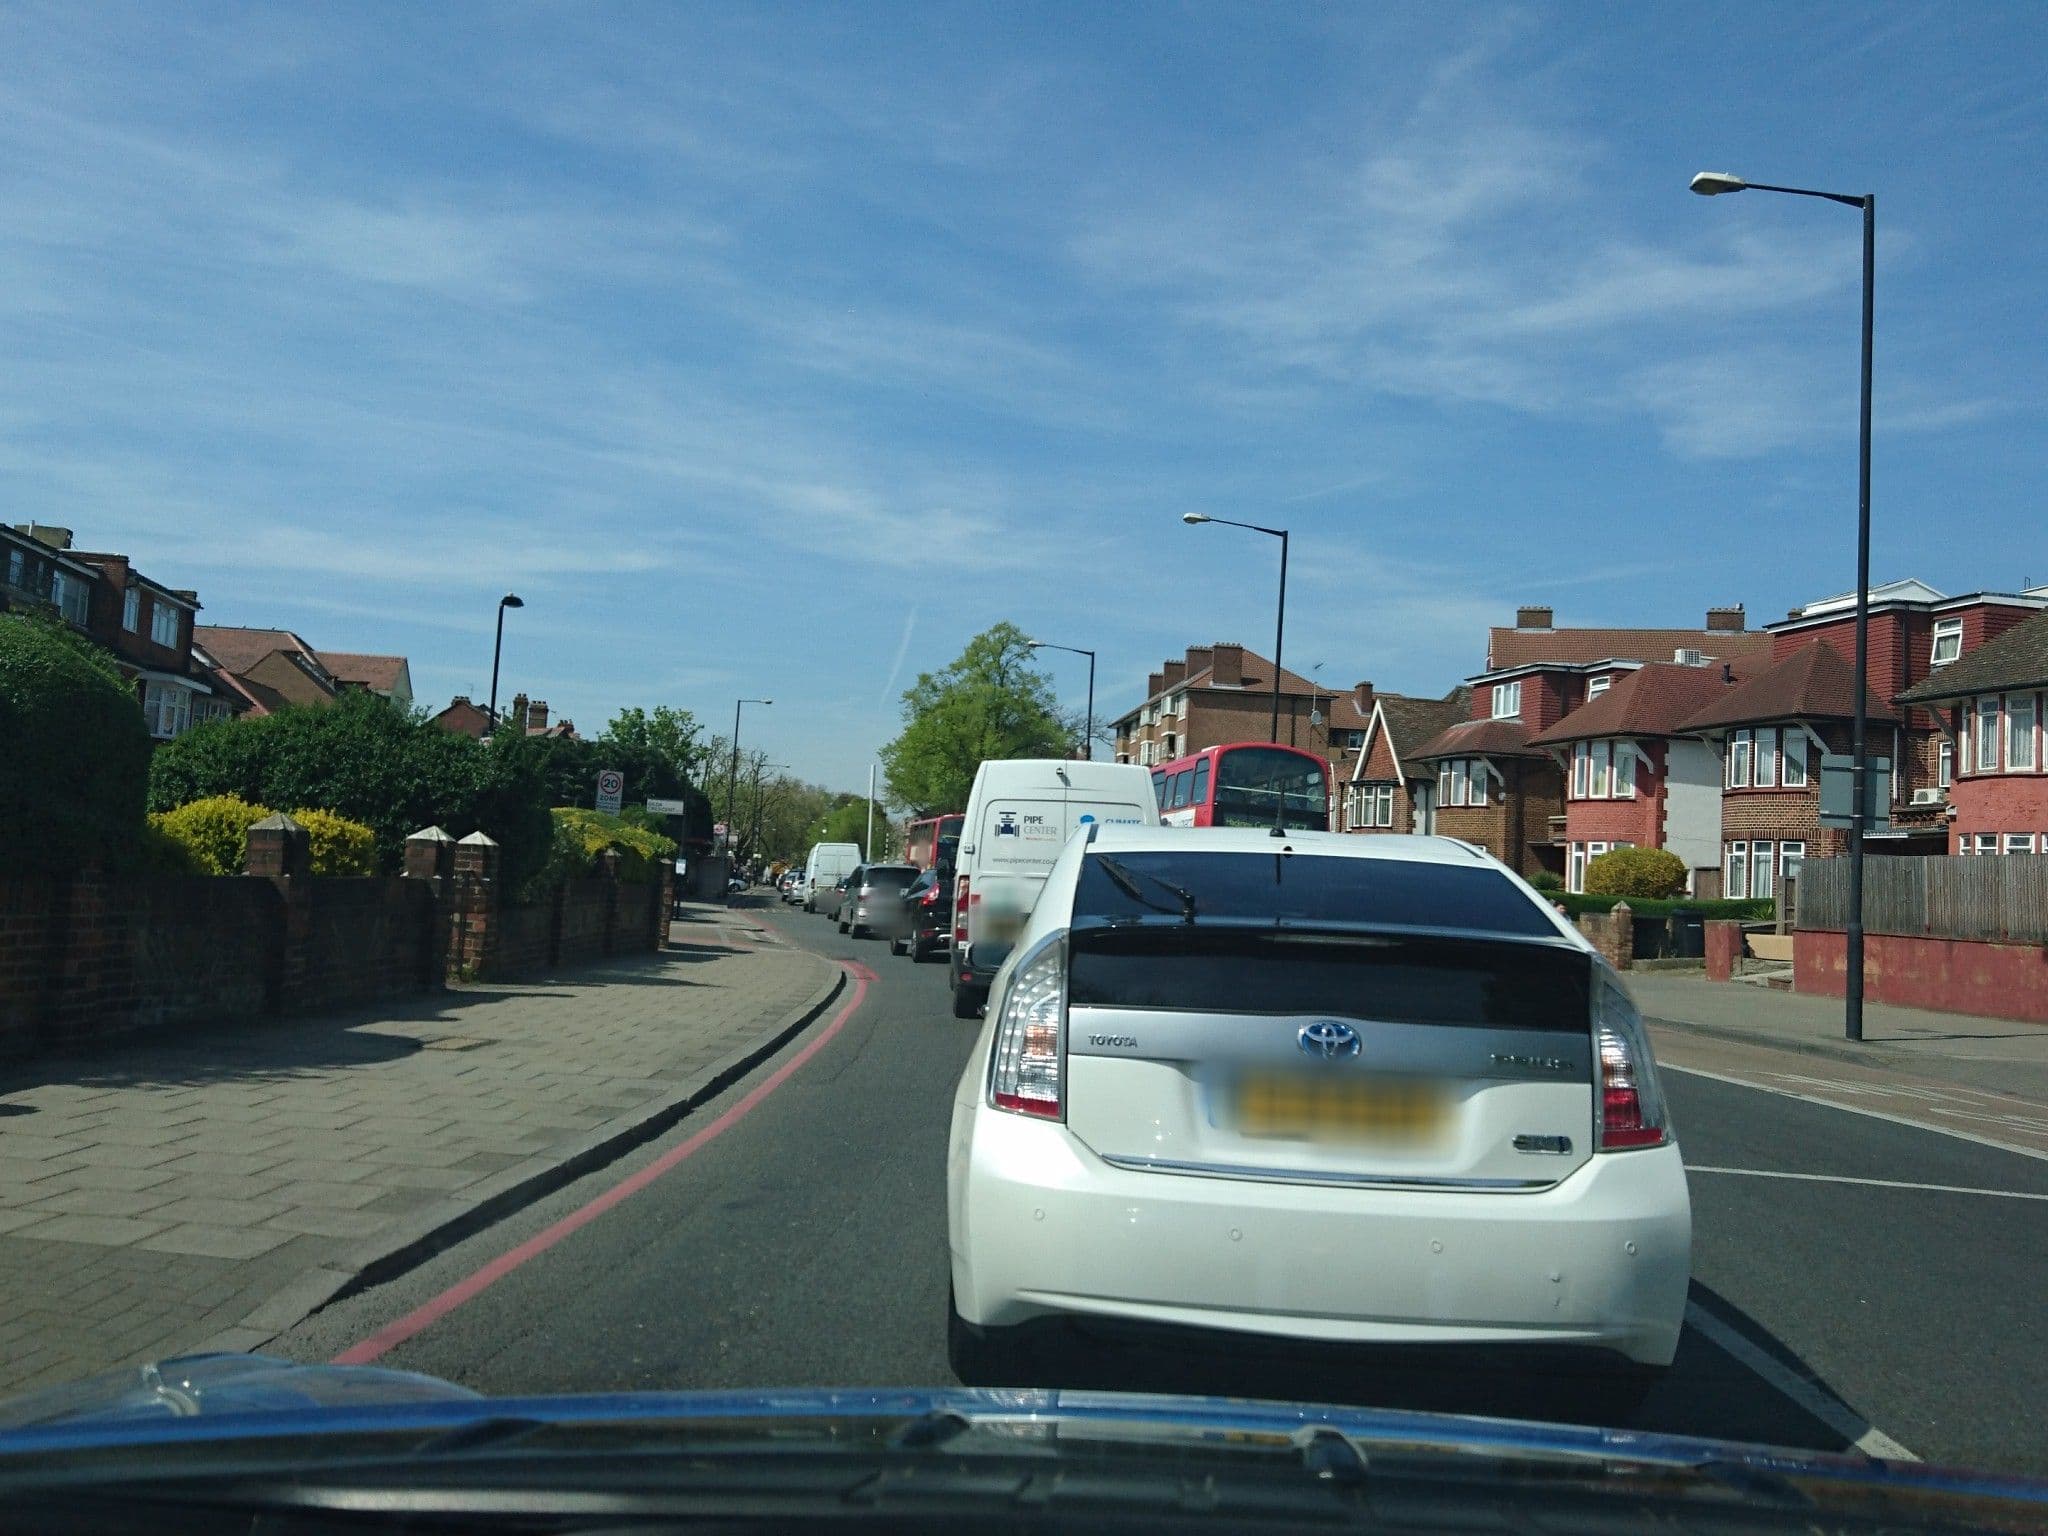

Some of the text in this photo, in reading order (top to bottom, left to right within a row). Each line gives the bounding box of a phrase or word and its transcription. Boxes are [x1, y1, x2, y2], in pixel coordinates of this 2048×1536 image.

[603, 778, 618, 789] 20
[599, 794, 619, 802] ZONE
[1023, 815, 1044, 825] PIPE
[1023, 826, 1057, 835] CENTER
[1088, 1035, 1137, 1047] TOYOTA
